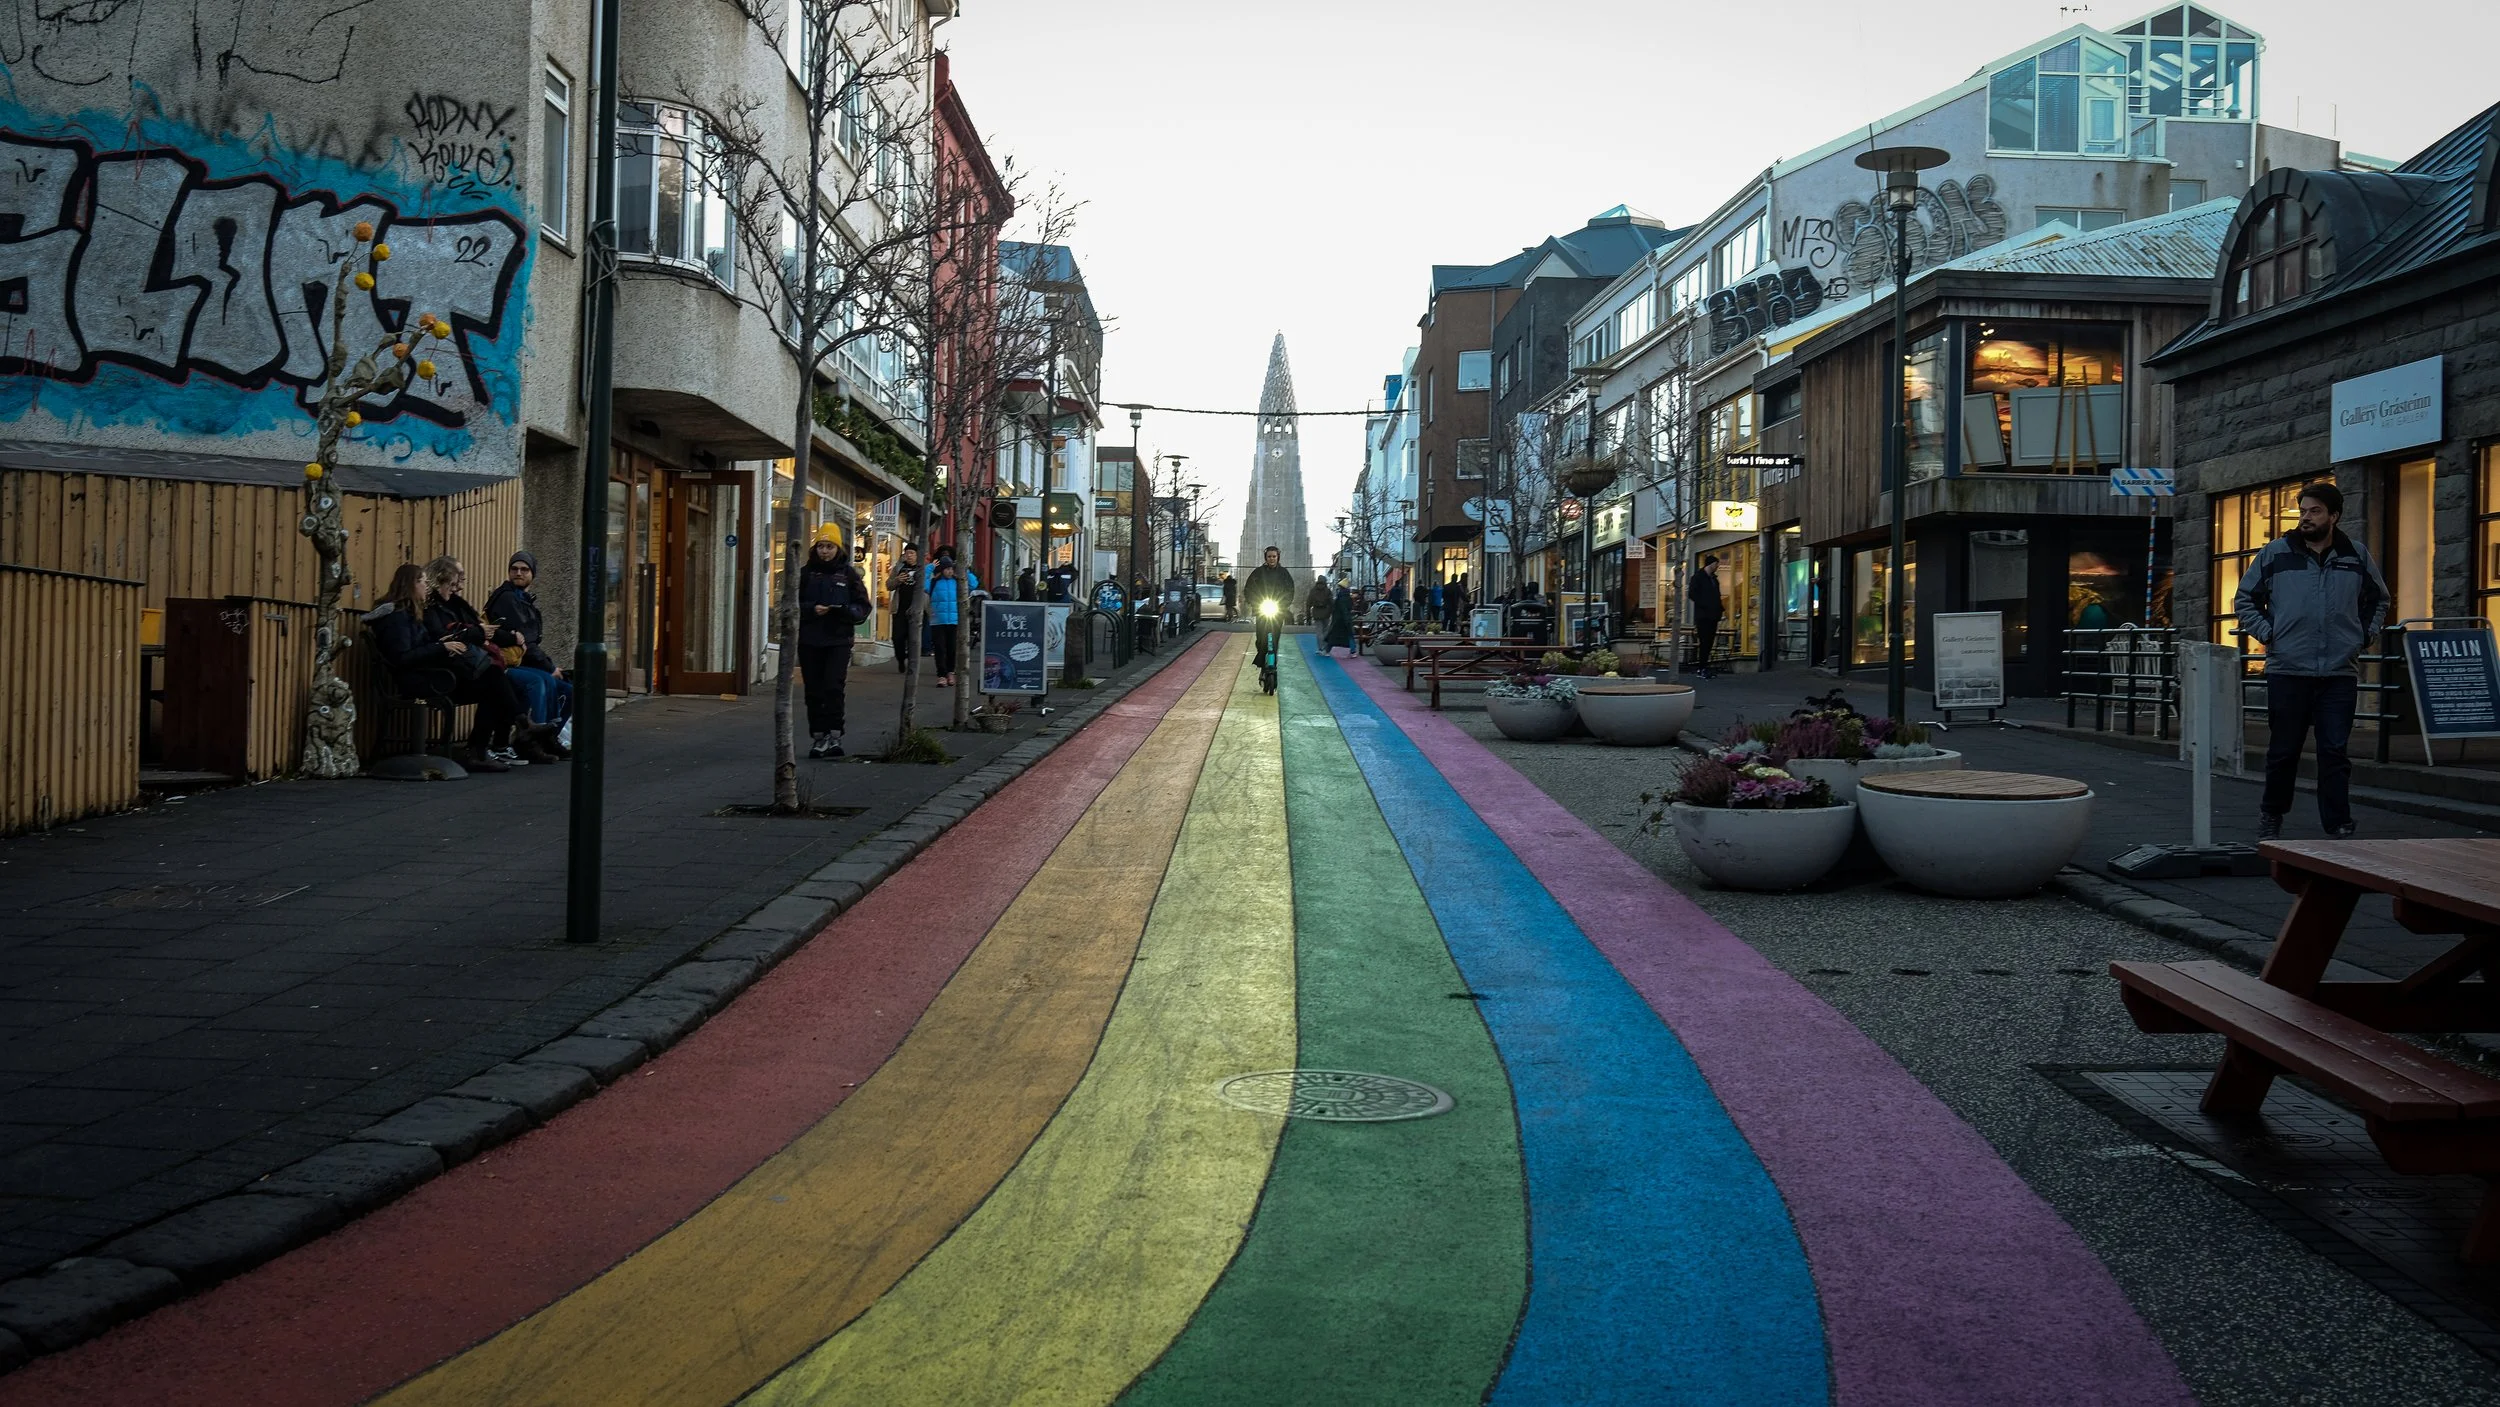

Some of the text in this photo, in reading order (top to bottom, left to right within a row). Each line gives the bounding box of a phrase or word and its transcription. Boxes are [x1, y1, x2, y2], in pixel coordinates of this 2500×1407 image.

[2340, 407, 2377, 426] Gallery
[1755, 456, 1774, 465] fine
[1775, 457, 1790, 465] art
[2418, 639, 2482, 658] HYALIN
